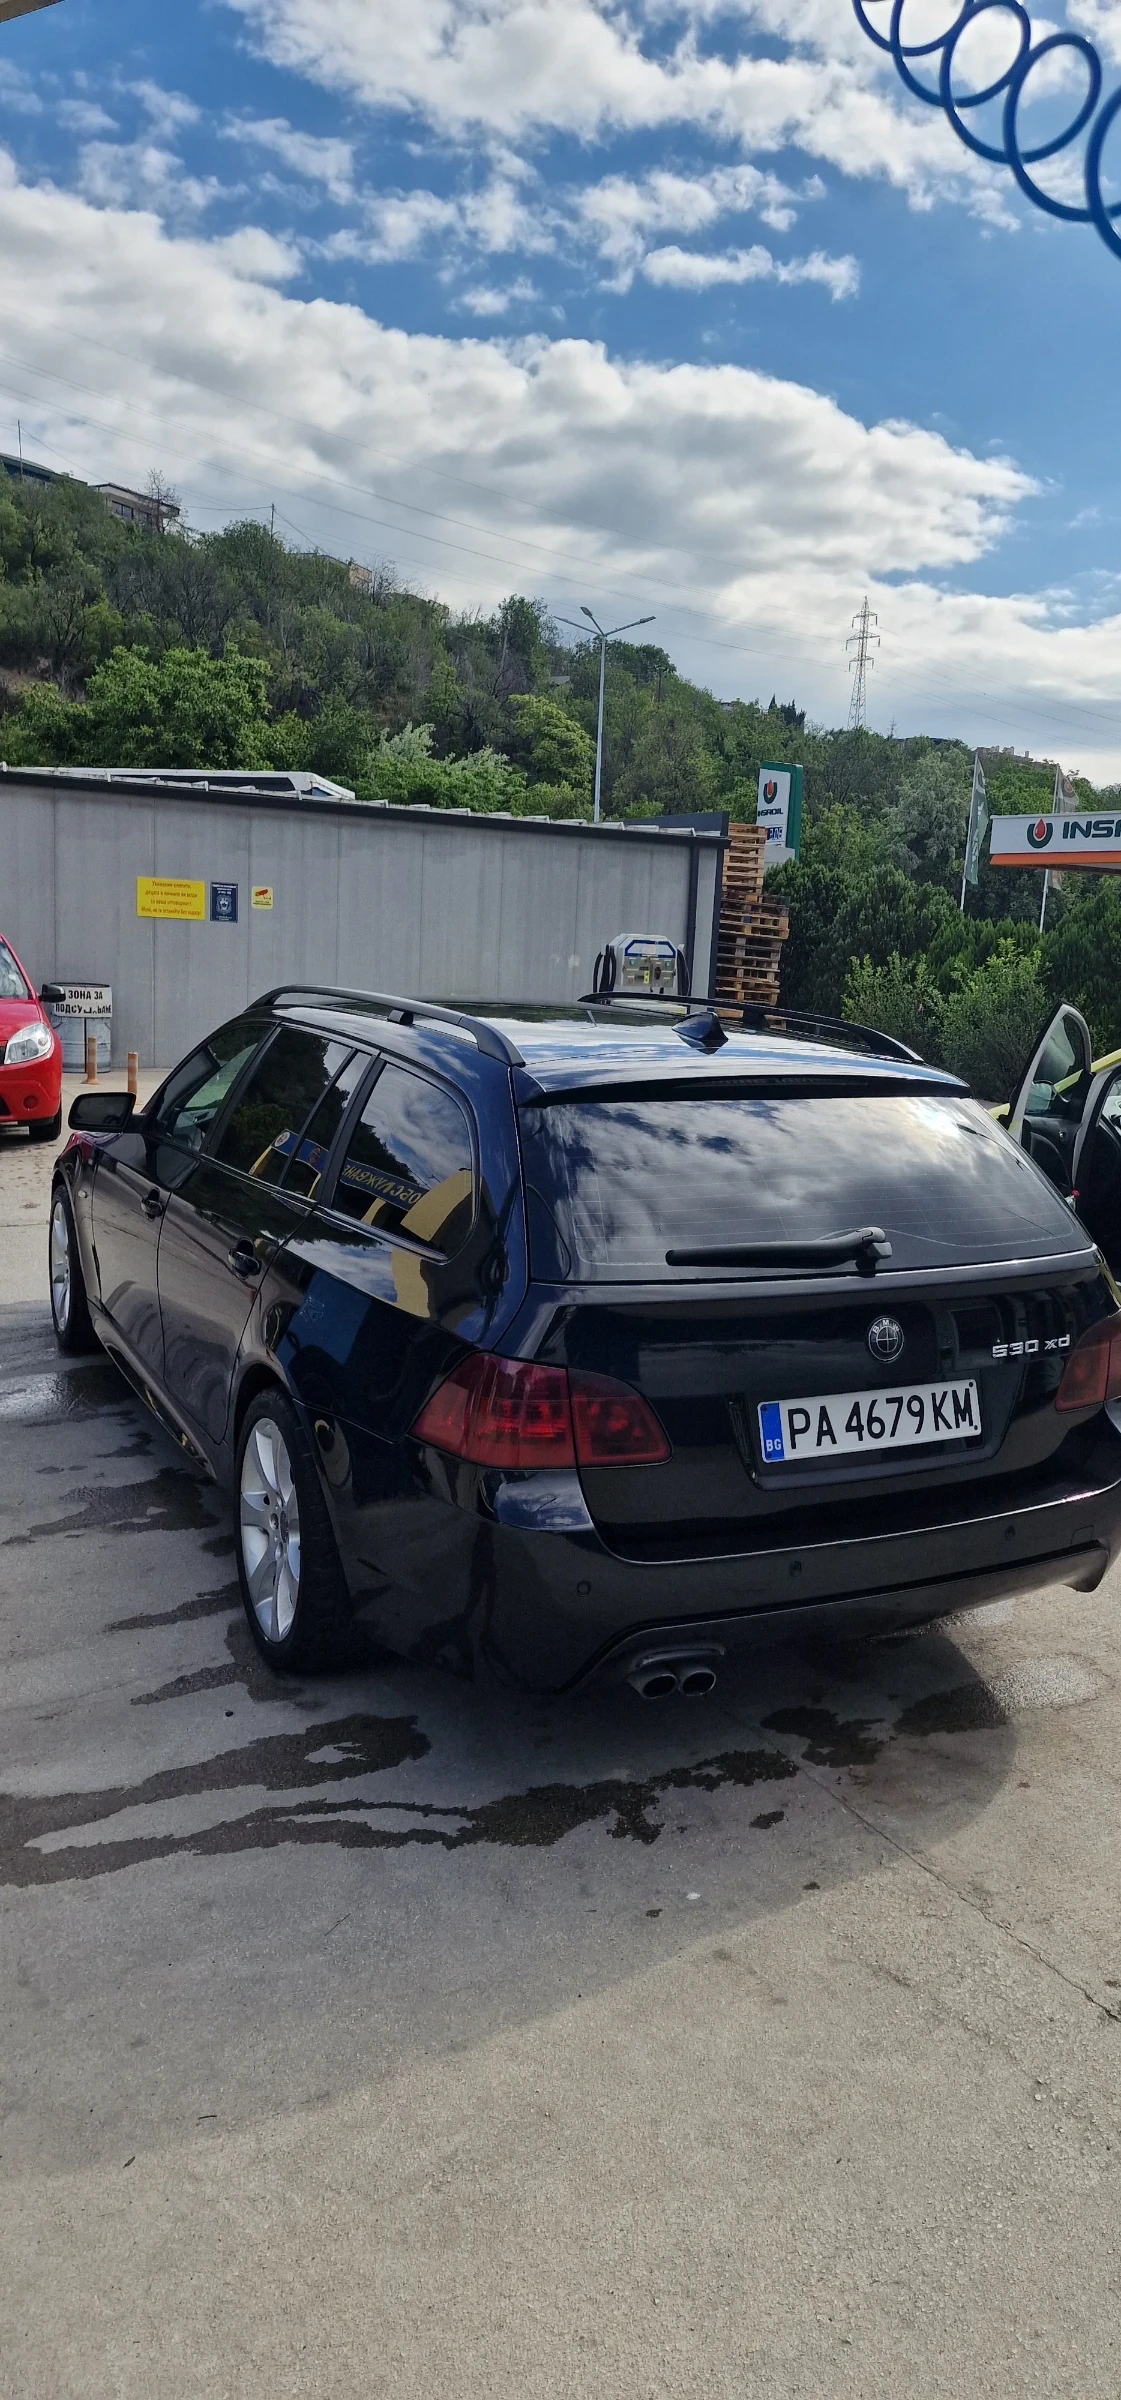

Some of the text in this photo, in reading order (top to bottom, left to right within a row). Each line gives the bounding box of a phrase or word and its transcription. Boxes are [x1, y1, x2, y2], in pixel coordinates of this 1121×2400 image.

[68, 990, 103, 1000] ЗОНА ЗА
[872, 1319, 900, 1334] BMW
[992, 1334, 1070, 1359] 530 xd
[787, 1388, 974, 1449] PA 4679 KM
[766, 1438, 782, 1451] BG
